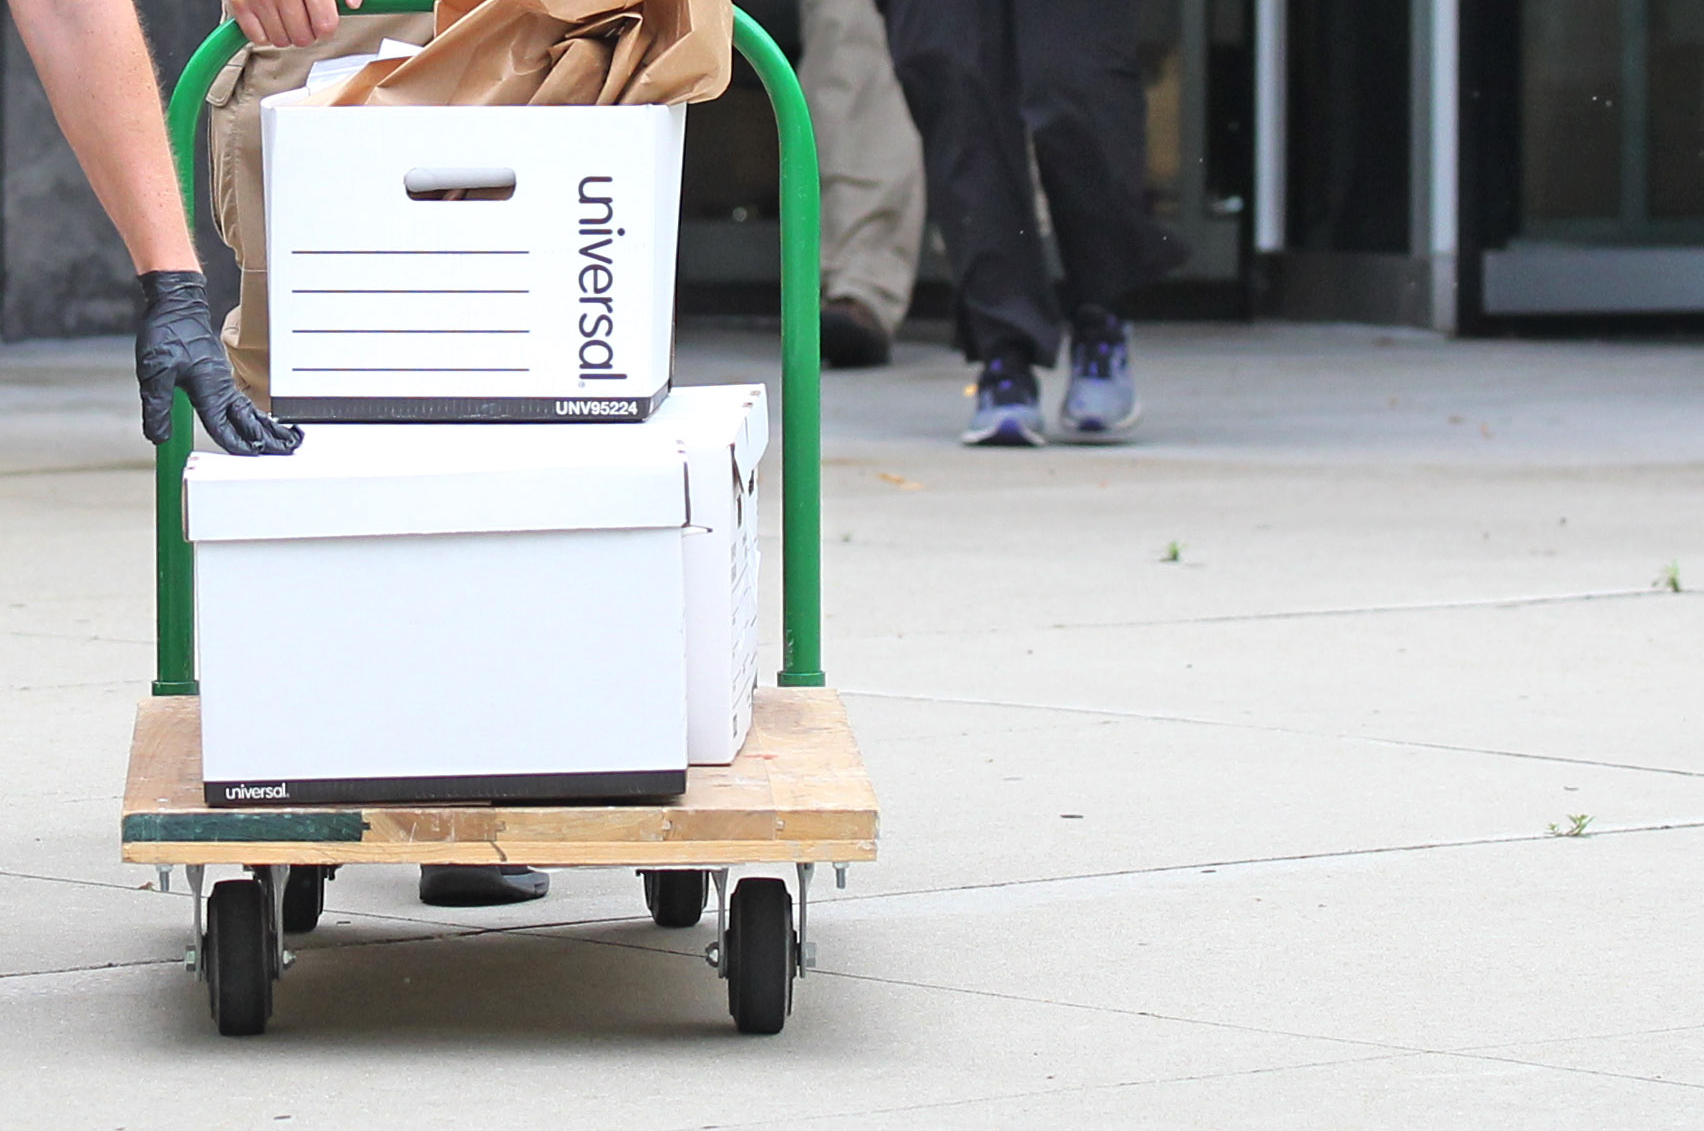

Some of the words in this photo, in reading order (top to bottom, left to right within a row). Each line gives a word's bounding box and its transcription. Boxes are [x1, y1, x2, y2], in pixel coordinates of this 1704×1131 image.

[578, 176, 628, 380] universal
[556, 400, 638, 415] UNV95224
[225, 782, 286, 800] universal
